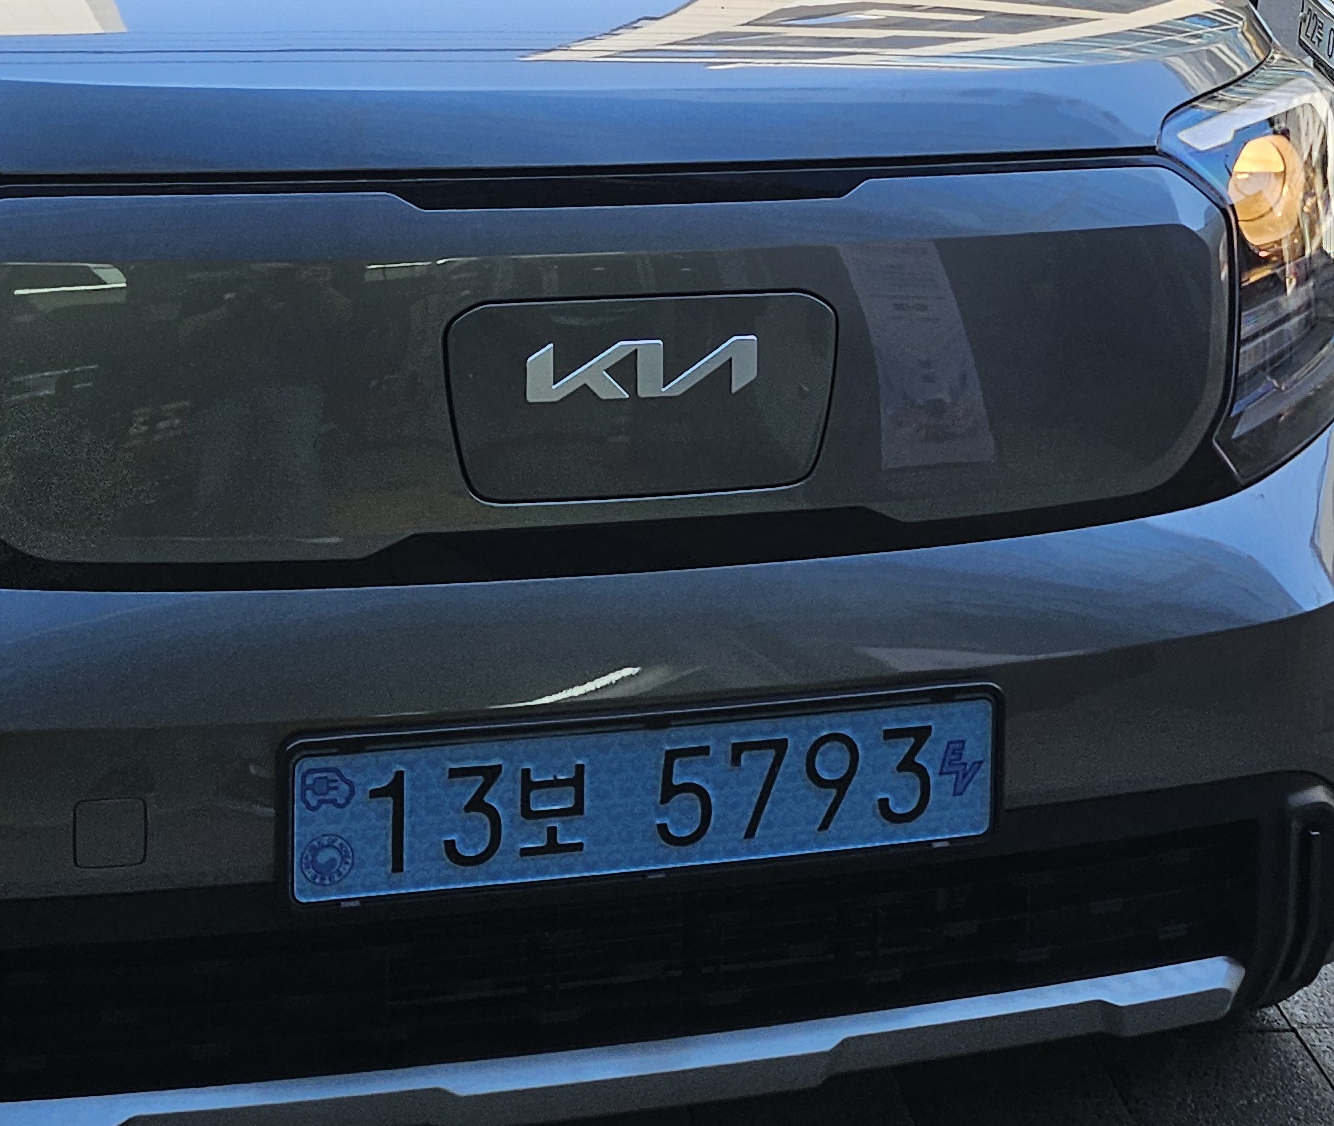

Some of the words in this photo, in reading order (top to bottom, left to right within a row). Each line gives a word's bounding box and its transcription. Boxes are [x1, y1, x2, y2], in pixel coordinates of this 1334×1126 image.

[526, 334, 758, 403] KIA
[368, 762, 586, 874] 13보
[655, 724, 935, 848] 5793
[938, 739, 985, 797] EV
